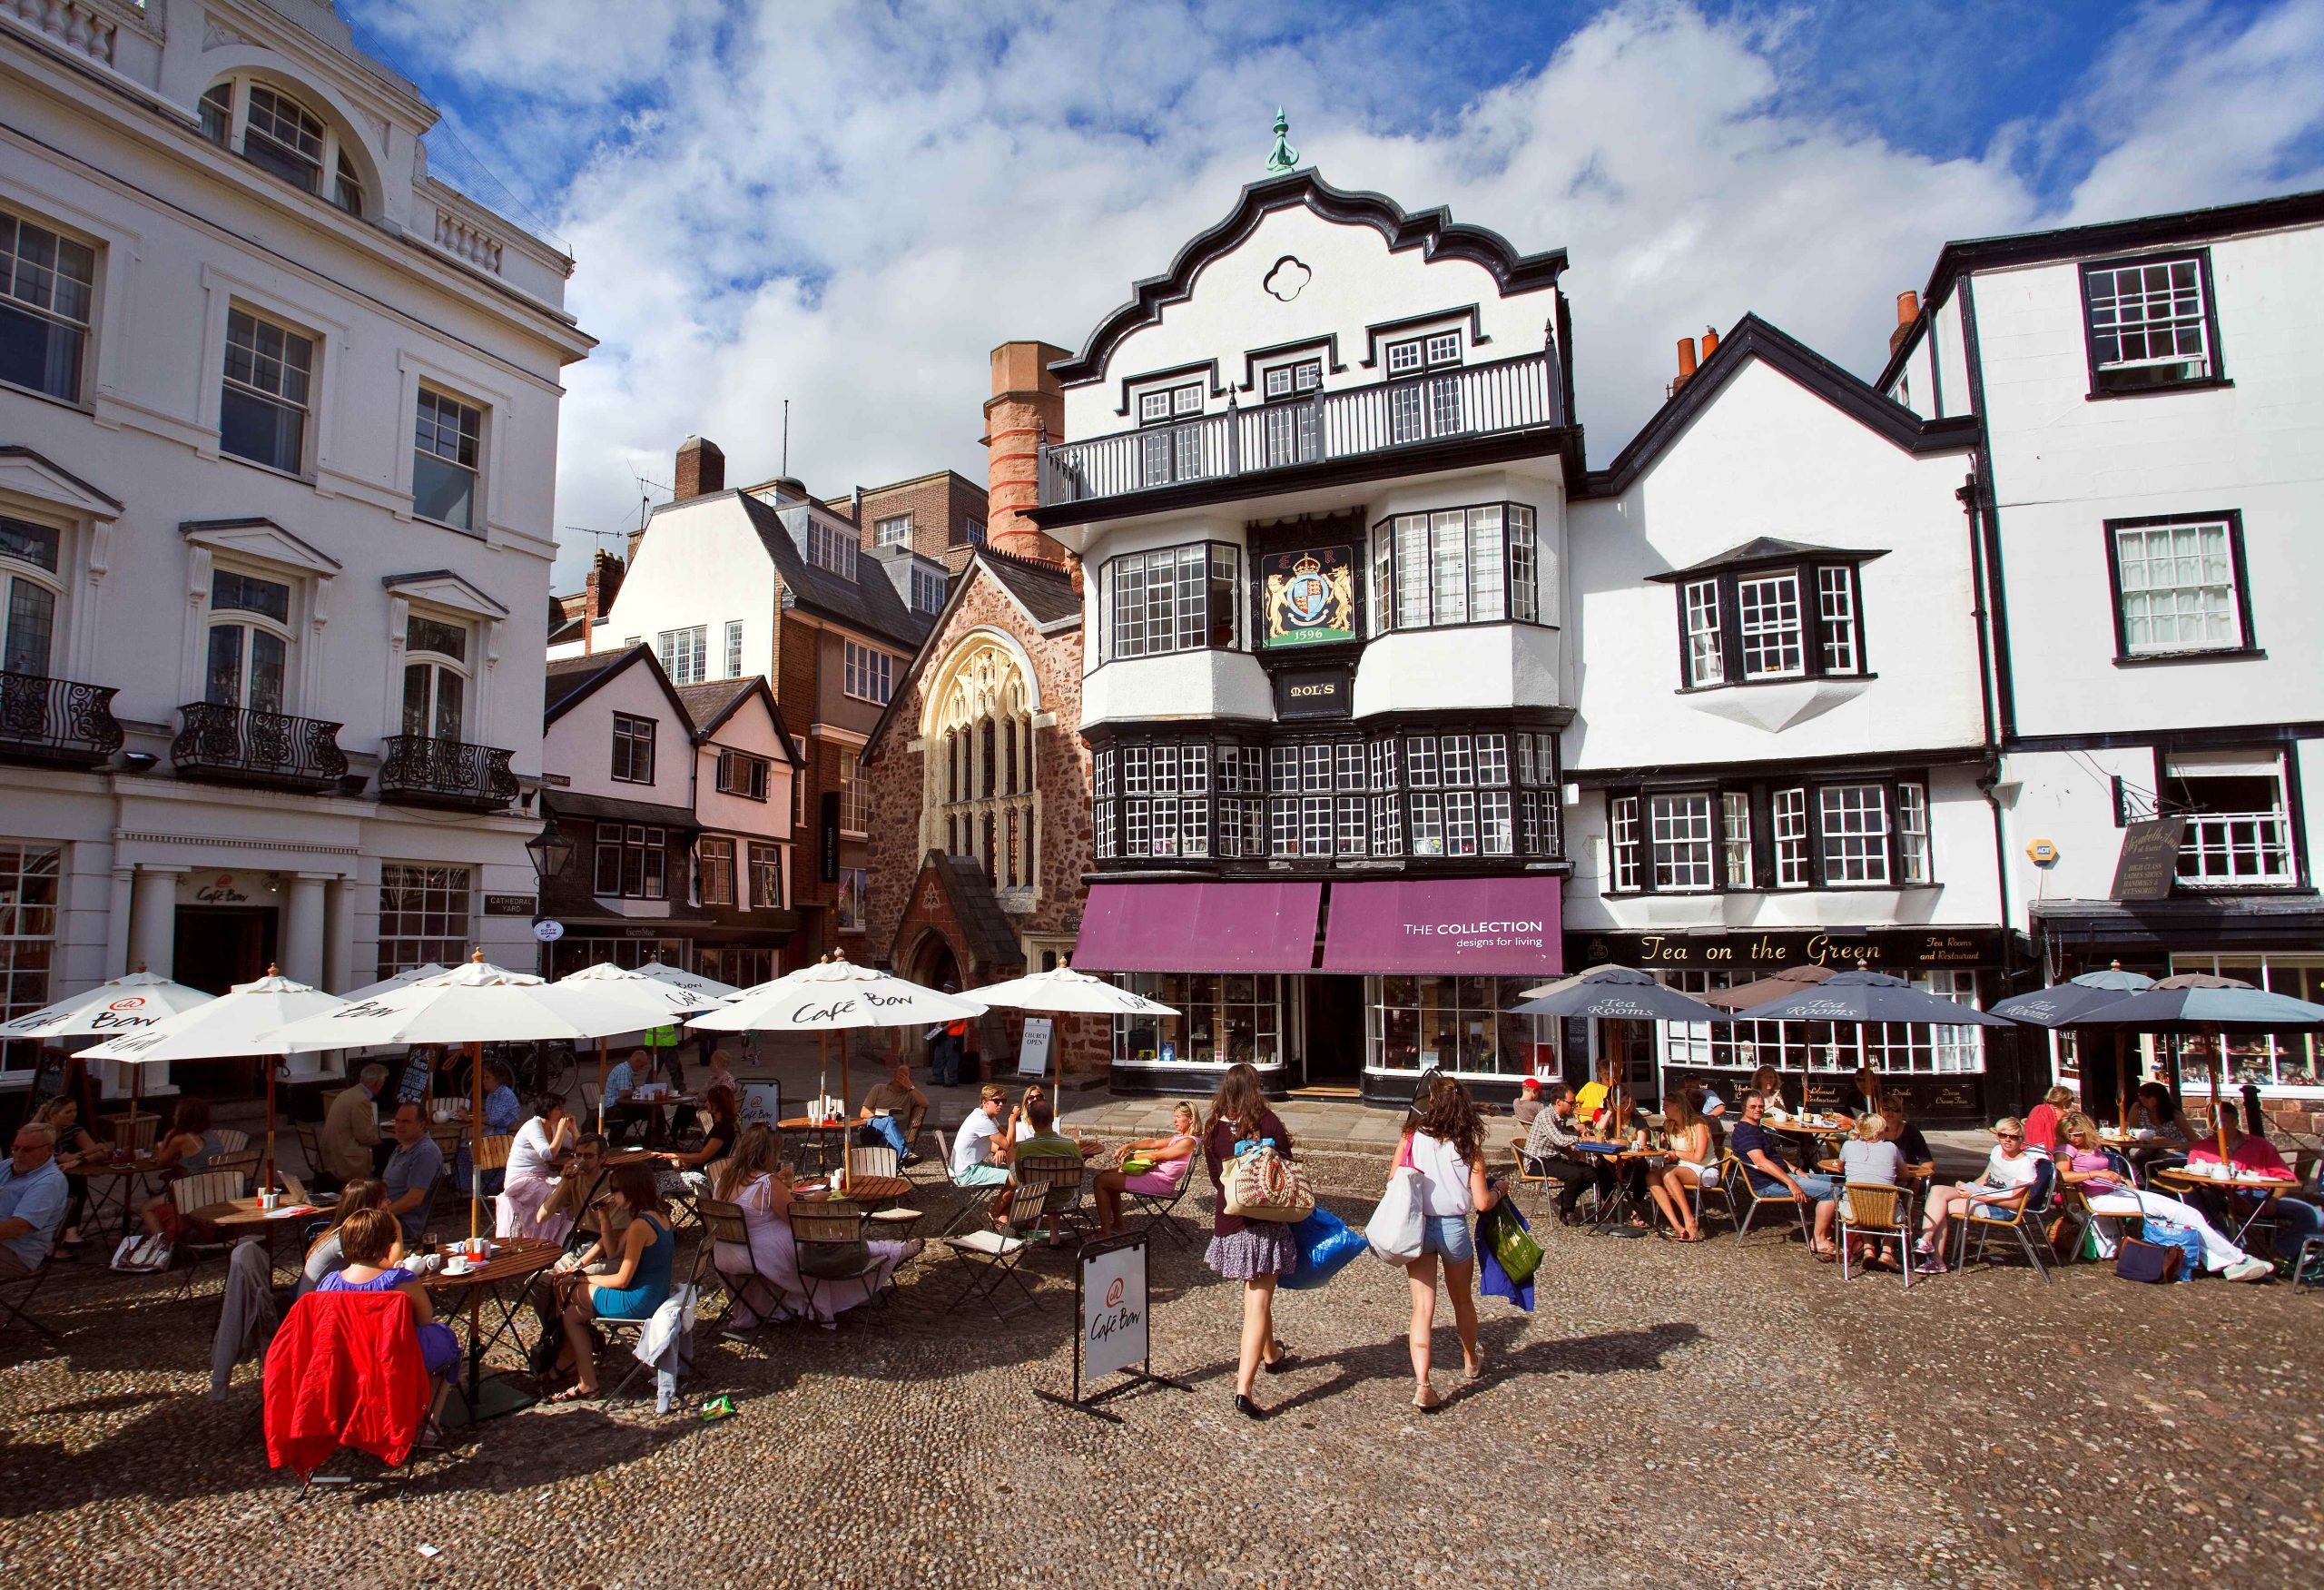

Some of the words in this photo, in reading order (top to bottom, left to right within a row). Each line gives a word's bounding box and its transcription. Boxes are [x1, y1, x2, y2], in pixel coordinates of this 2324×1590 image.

[1294, 630, 1323, 640] 1596
[1290, 684, 1334, 696] MOL'S
[827, 849, 832, 858] OF
[2128, 864, 2143, 872] HIGH
[196, 886, 223, 904] Café
[225, 888, 250, 902] Bar
[490, 896, 532, 905] CATHEDRAL
[1403, 924, 1433, 935] THE
[1437, 921, 1542, 935] COLLECTION
[1456, 938, 1494, 948] designs
[1497, 937, 1513, 946] for
[1515, 937, 1543, 947] living
[1926, 937, 1944, 947] Tea
[1946, 937, 1972, 946] Rooms
[1641, 936, 1688, 960] Tea
[1706, 947, 1733, 960] on
[1751, 935, 1786, 959] the
[1807, 934, 1881, 966] Green
[1919, 950, 1935, 960] and
[1937, 950, 1979, 960] Restaurant
[792, 1001, 857, 1022] Café
[863, 992, 913, 1006] Bar
[1600, 998, 1637, 1010] Tea
[1807, 998, 1847, 1010] Tea
[2028, 1000, 2058, 1012] Tea
[1587, 1004, 1654, 1017] Rooms
[1786, 1005, 1857, 1017] Rooms
[2004, 1005, 2053, 1020] Rooms
[91, 1012, 162, 1030] Bar
[2058, 1031, 2077, 1041] SALE
[1090, 1313, 1117, 1342] Café
[1119, 1308, 1141, 1329] Bar
